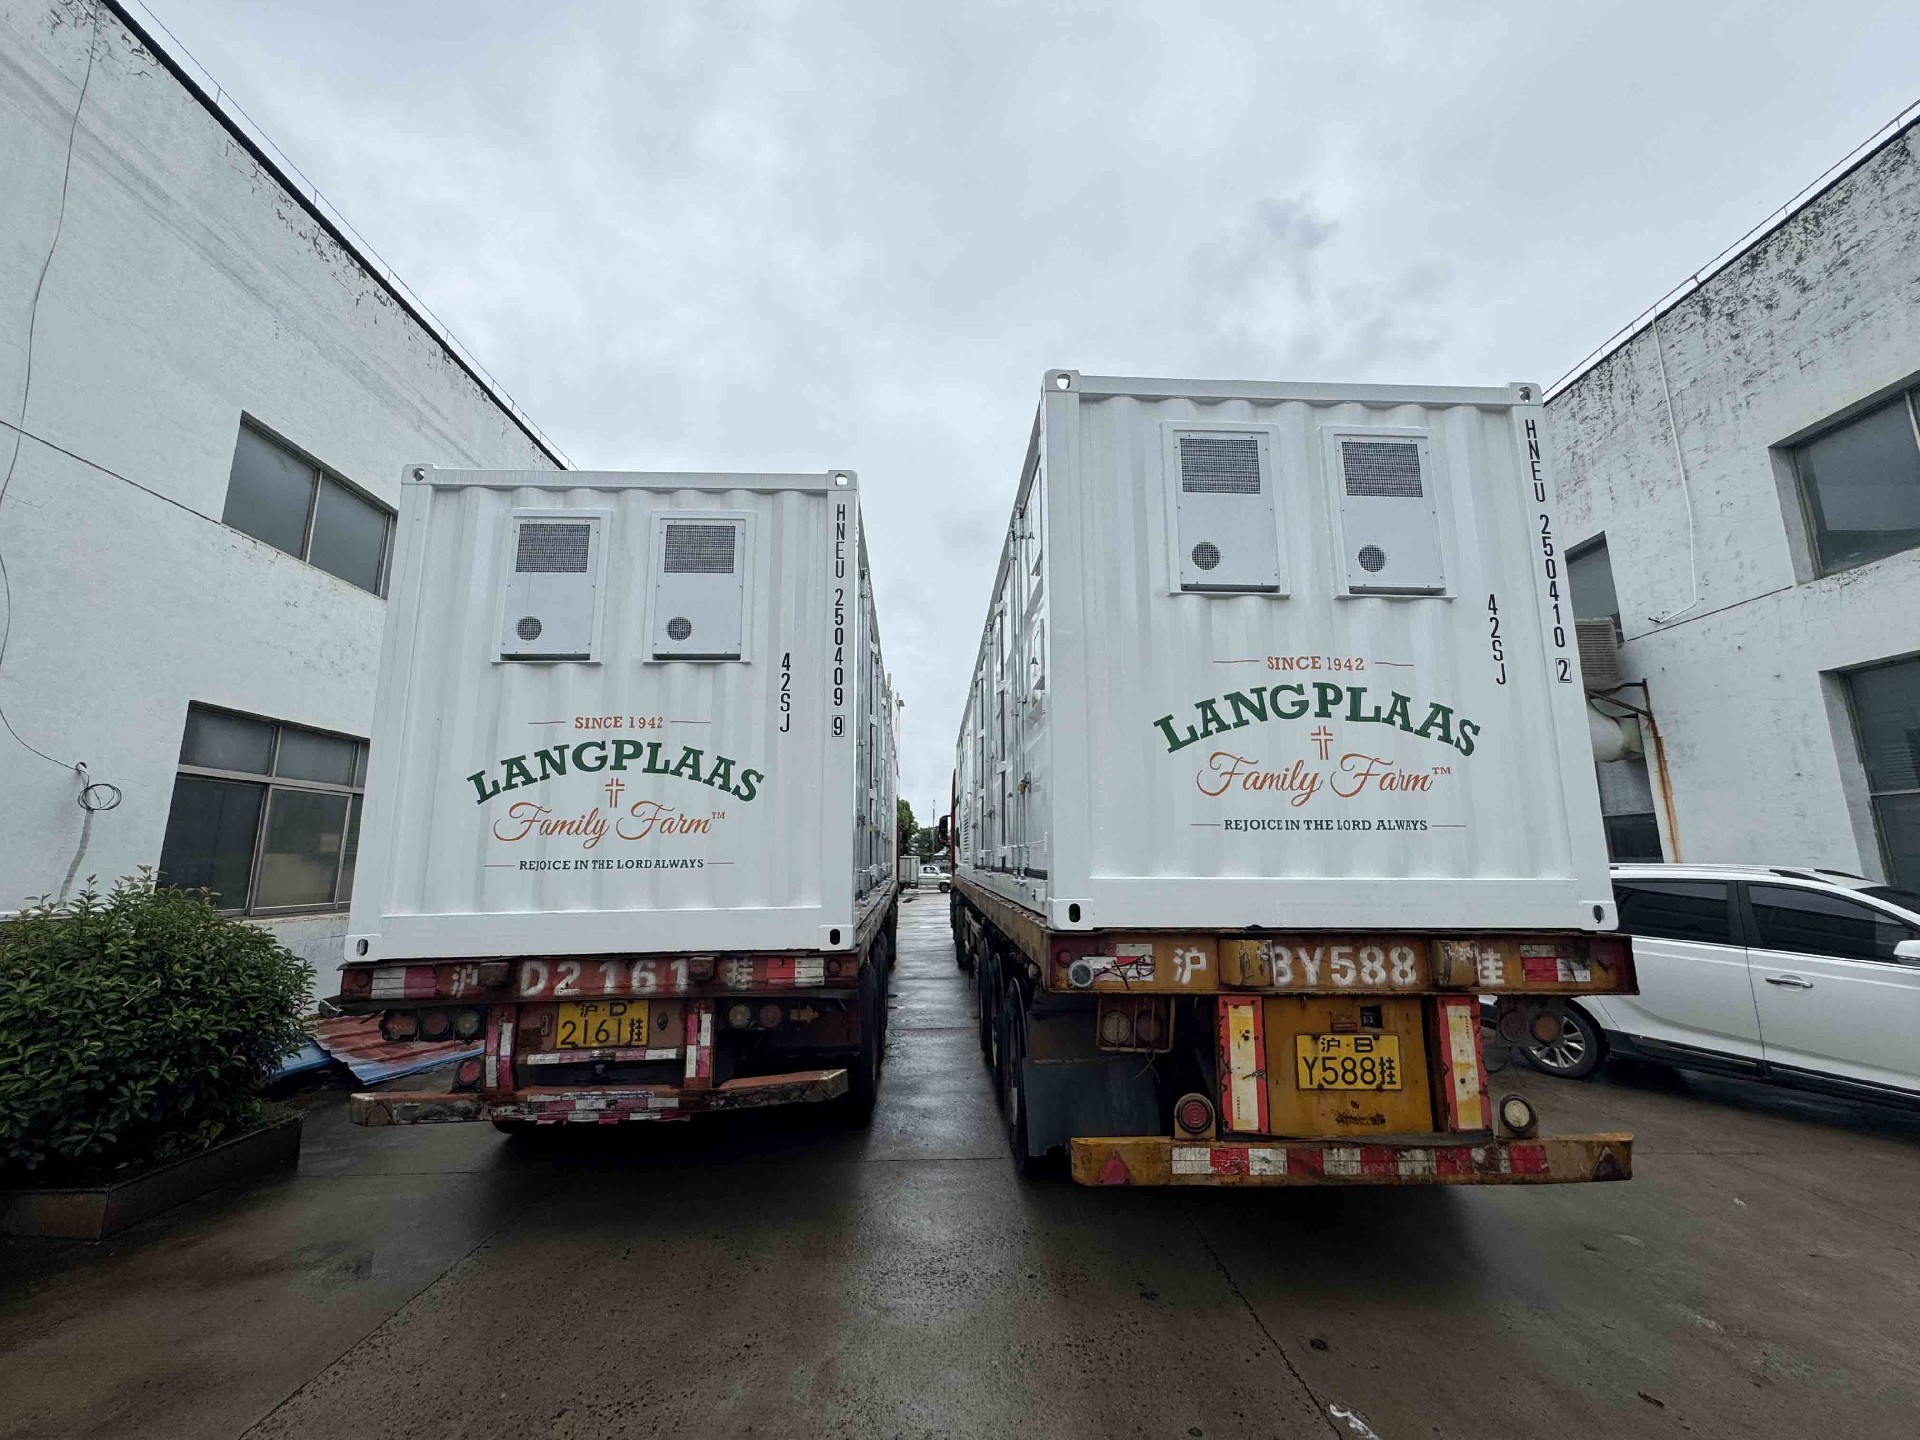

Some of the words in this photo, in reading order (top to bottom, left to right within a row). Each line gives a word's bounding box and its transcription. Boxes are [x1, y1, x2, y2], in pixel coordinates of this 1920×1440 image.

[835, 503, 846, 579] HNEU
[1525, 419, 1546, 502] HNEU
[1539, 514, 1567, 647] 250410
[1557, 659, 1570, 682] 2
[833, 588, 845, 706] 250409
[1267, 656, 1321, 671] SINCE
[1327, 657, 1365, 671] 1942
[1488, 593, 1507, 685] 42SJ
[779, 652, 791, 733] 42SJ
[575, 716, 623, 729] SINCE
[629, 716, 663, 729] 1942
[833, 717, 843, 736] 9
[1153, 682, 1481, 757] LANGPLAAS
[466, 739, 765, 806] LANGPLAAS
[1196, 751, 1323, 807] Family
[493, 801, 610, 849] Family
[1223, 819, 1283, 832] REJOICE
[1285, 819, 1301, 831] IN
[1303, 819, 1334, 831] THE
[1336, 819, 1372, 831] LORD
[1375, 819, 1428, 831] ALWAYS
[519, 859, 571, 871] REJOICE
[573, 859, 589, 870] IN
[591, 859, 614, 870] THE
[616, 858, 652, 869] LORD
[653, 858, 704, 869] ALWAYS
[1173, 947, 1206, 984] 沪
[1302, 1056, 1397, 1086] Y588挂
